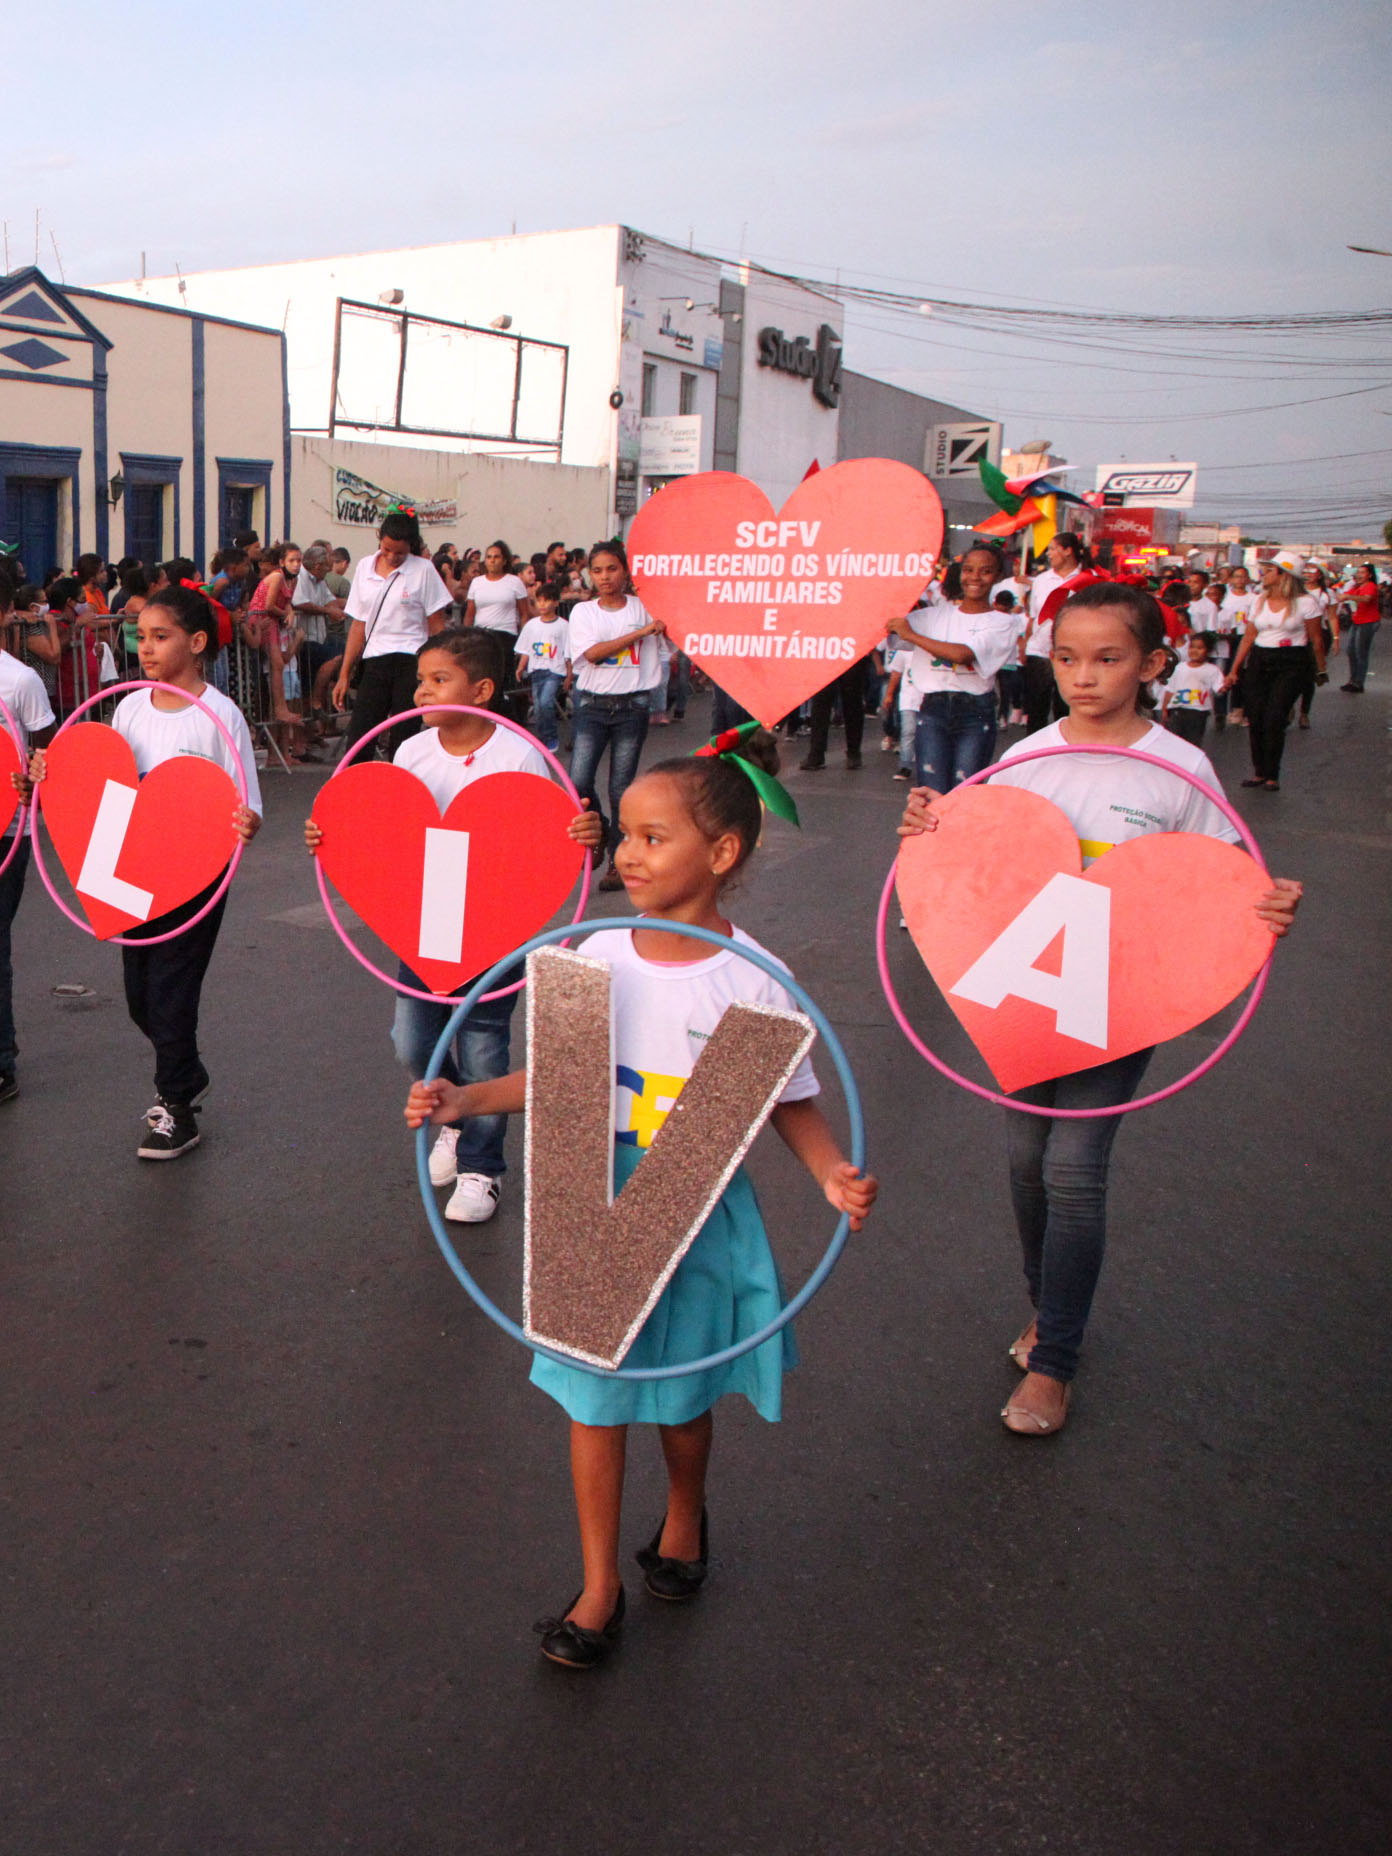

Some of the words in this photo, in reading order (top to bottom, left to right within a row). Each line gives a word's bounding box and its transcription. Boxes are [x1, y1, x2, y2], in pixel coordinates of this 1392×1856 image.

[936, 431, 947, 474] STUDIO
[736, 521, 821, 548] SCFV
[632, 554, 784, 577] FORTALECENDO
[791, 554, 819, 577] OS
[826, 548, 934, 577] VÍNCULOS
[707, 581, 843, 604] FAMILIARES
[764, 608, 778, 631] E
[684, 630, 856, 660] COMUNITÁRIOS
[76, 778, 154, 921] L
[418, 827, 470, 963] I
[948, 872, 1111, 1050] A
[522, 945, 817, 1370] V
